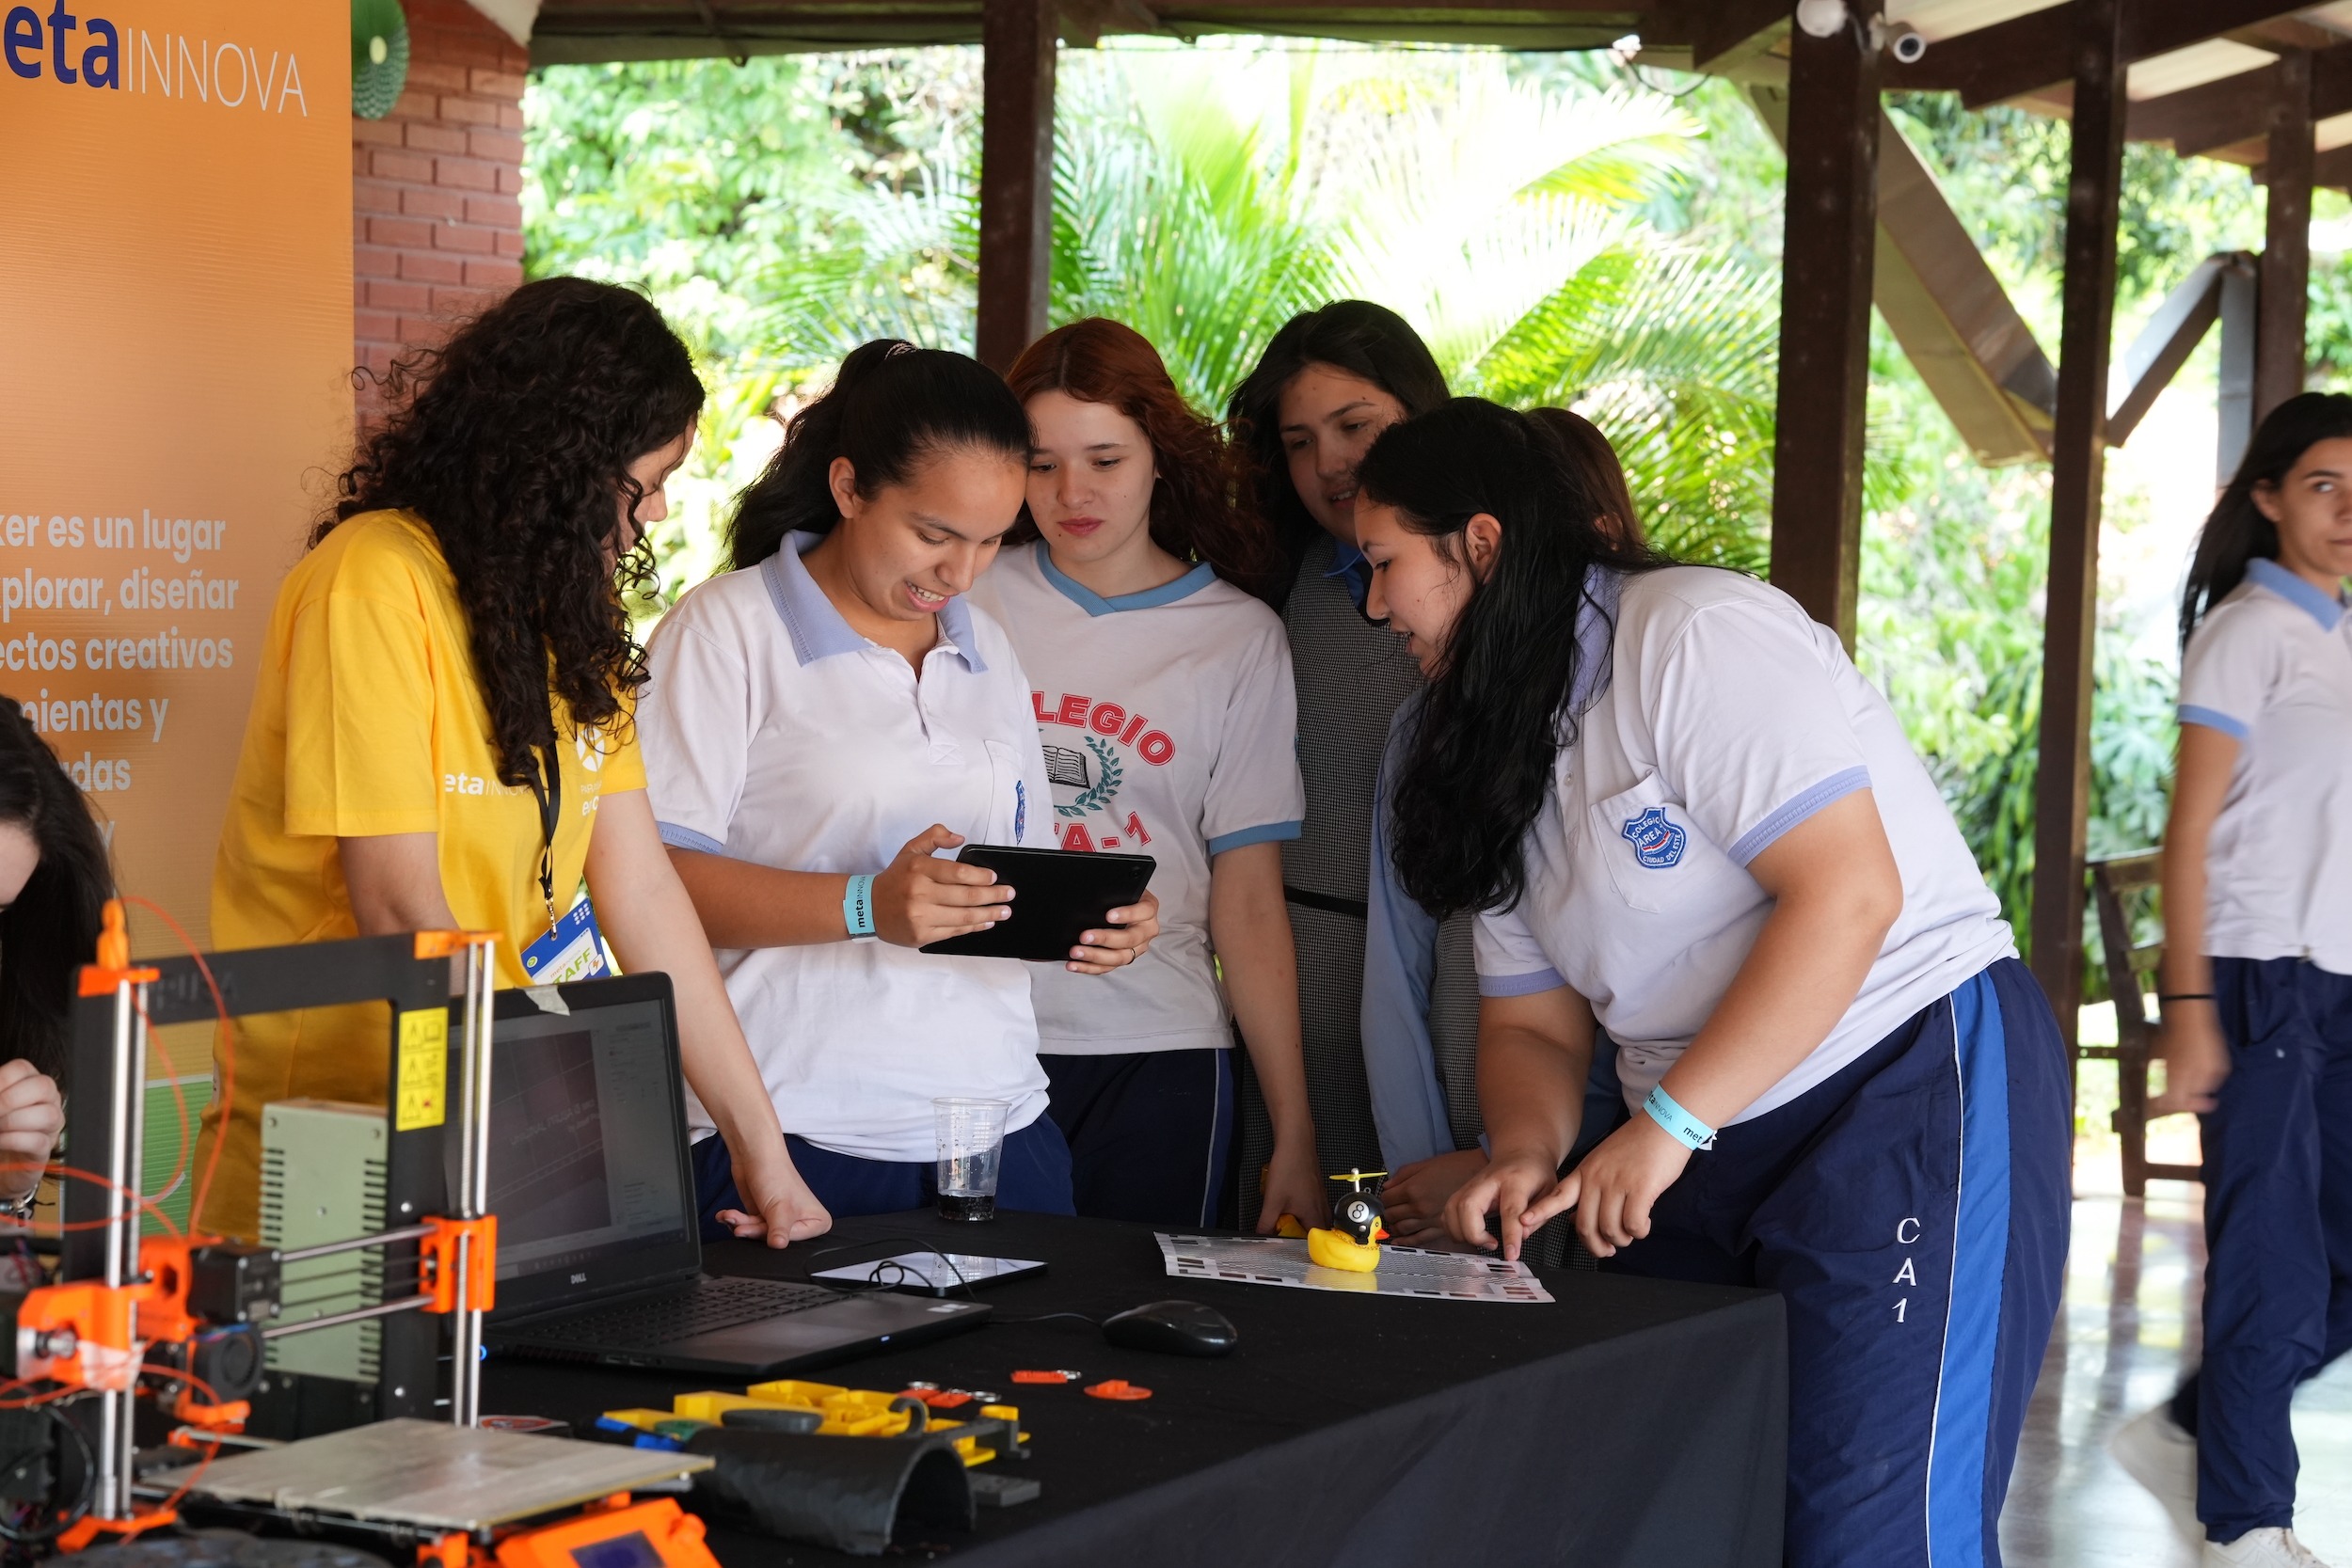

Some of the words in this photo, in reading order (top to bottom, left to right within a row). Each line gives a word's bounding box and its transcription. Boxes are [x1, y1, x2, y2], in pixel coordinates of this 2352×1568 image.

[0, 515, 40, 547] er
[48, 516, 85, 548] es
[94, 516, 135, 549] un
[143, 509, 226, 563] lugar
[0, 567, 112, 624] plorar,
[119, 566, 239, 610] diseñar
[86, 626, 233, 670] creativos
[149, 698, 169, 743] y
[1632, 816, 1661, 838] COLEGIO
[1638, 827, 1662, 847] AREA
[1643, 855, 1665, 863] CIUDAD
[1666, 850, 1677, 861] DEL
[1673, 833, 1681, 850] ESTE
[1352, 1203, 1364, 1220] 8
